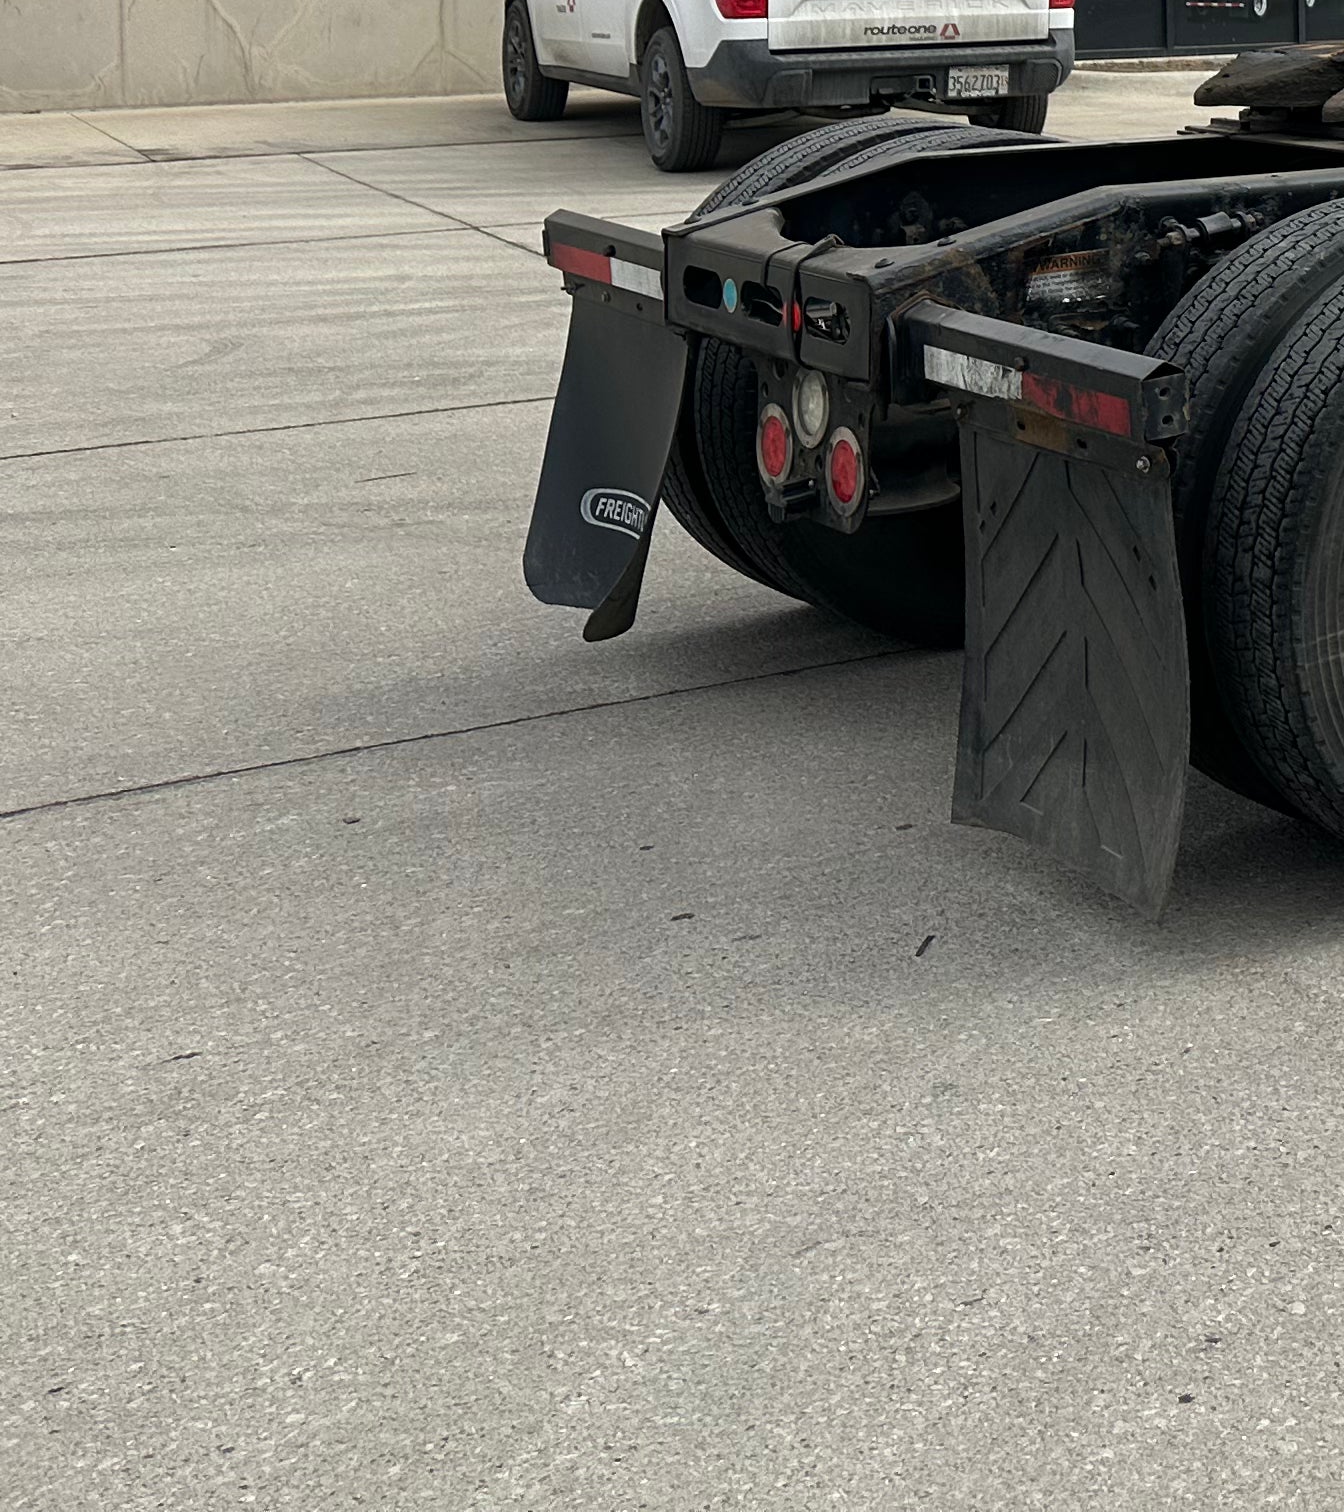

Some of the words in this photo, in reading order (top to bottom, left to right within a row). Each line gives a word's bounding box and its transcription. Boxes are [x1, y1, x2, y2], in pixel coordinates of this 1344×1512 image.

[864, 24, 937, 36] routeone
[949, 74, 1000, 92] 3562703
[1040, 252, 1100, 270] WARNING
